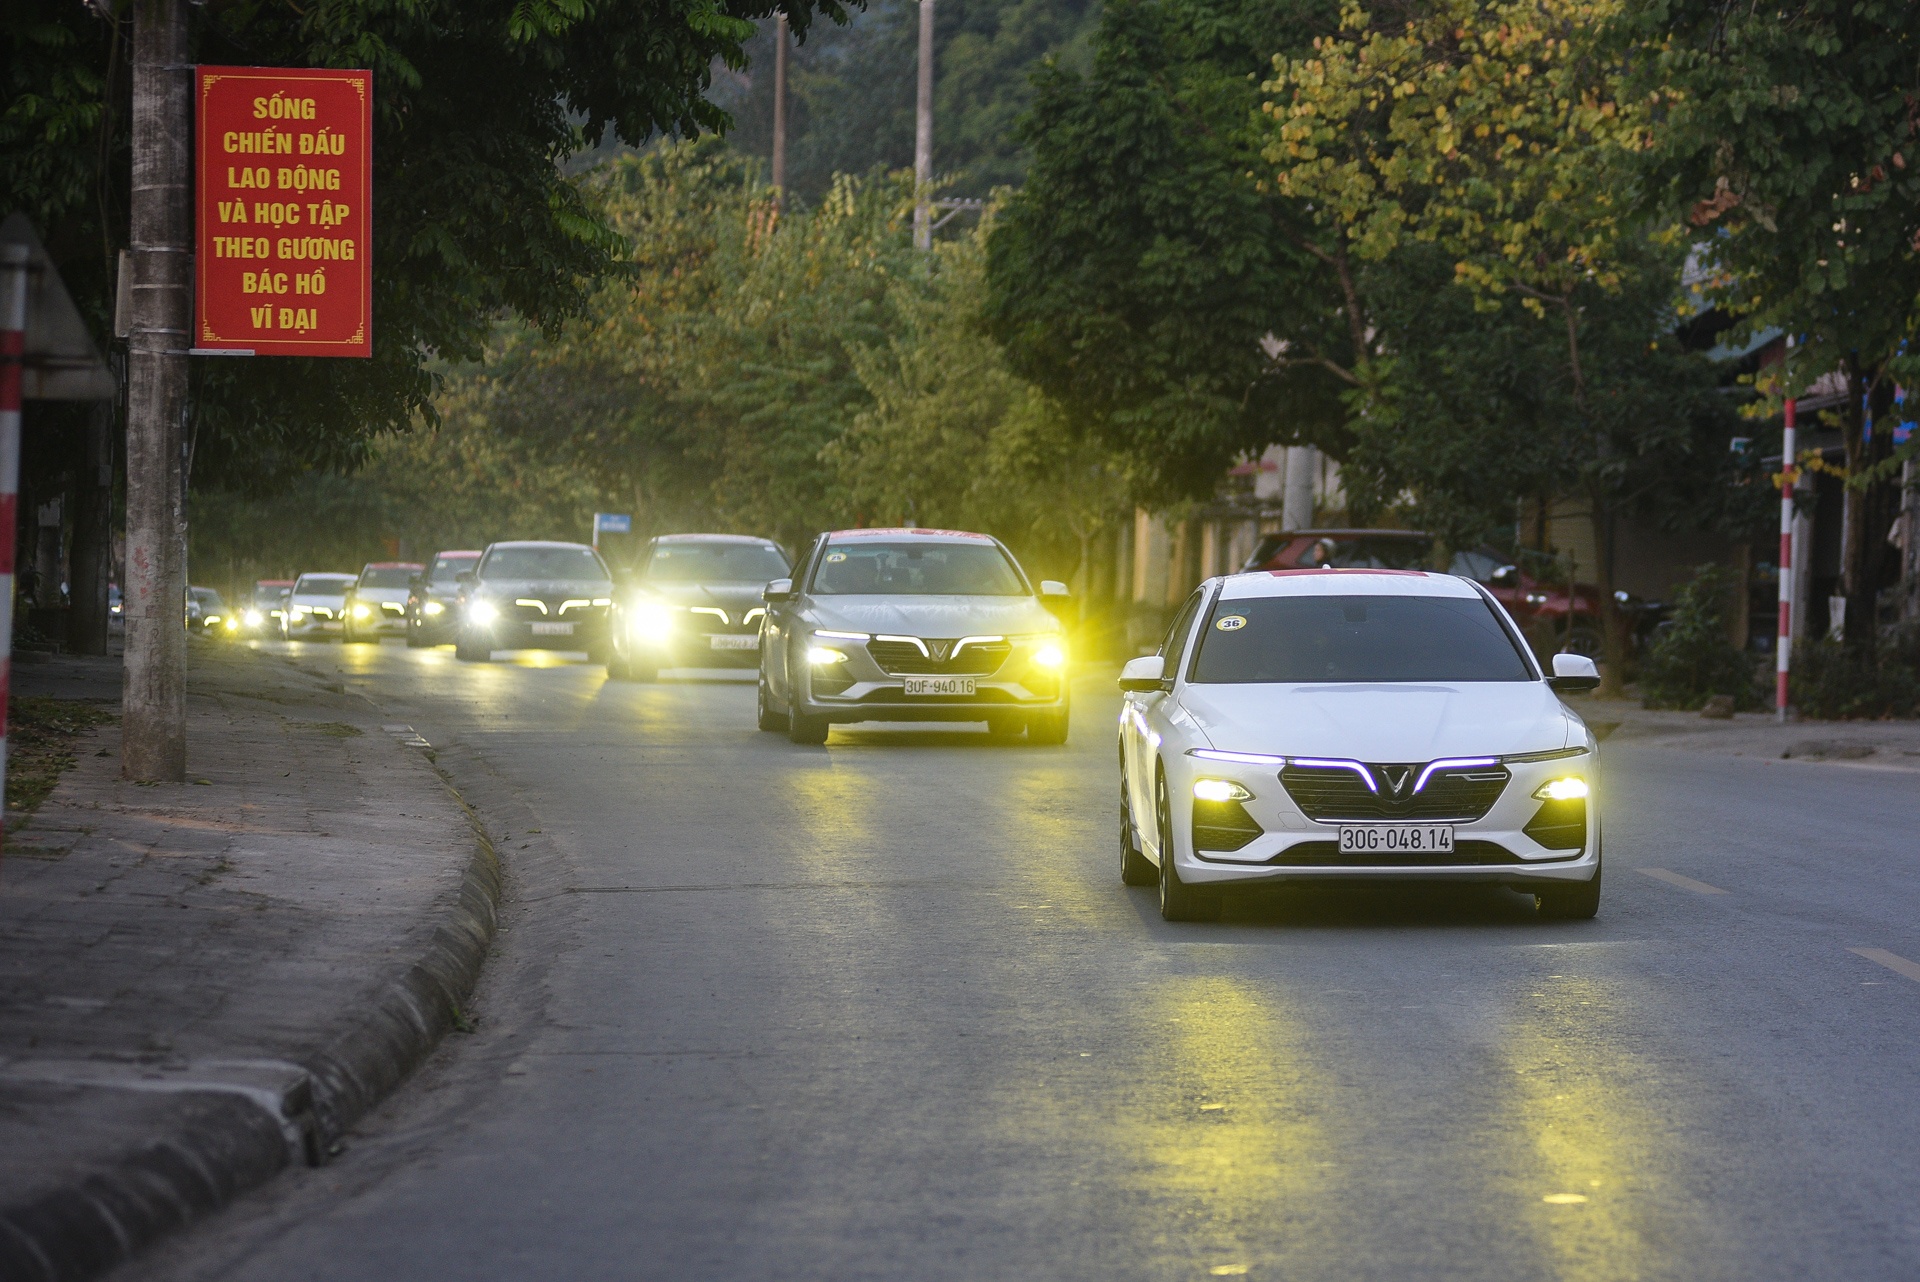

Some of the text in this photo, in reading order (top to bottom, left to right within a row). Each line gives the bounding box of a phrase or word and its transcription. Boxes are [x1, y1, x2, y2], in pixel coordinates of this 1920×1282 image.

[254, 91, 315, 119] SỐNG
[224, 126, 344, 155] CHIẾN ĐẤU
[229, 164, 340, 194] LAO ĐỘNG
[218, 198, 349, 229] VÀ HỌC TẬP
[213, 237, 354, 260] THEO GƯƠNG
[243, 267, 325, 294] BÁC HỒ
[251, 304, 316, 334] VĨ ĐẠI
[1223, 619, 1240, 628] 36
[906, 680, 974, 693] 30F-940.16
[1342, 828, 1450, 850] 30G-048.14
